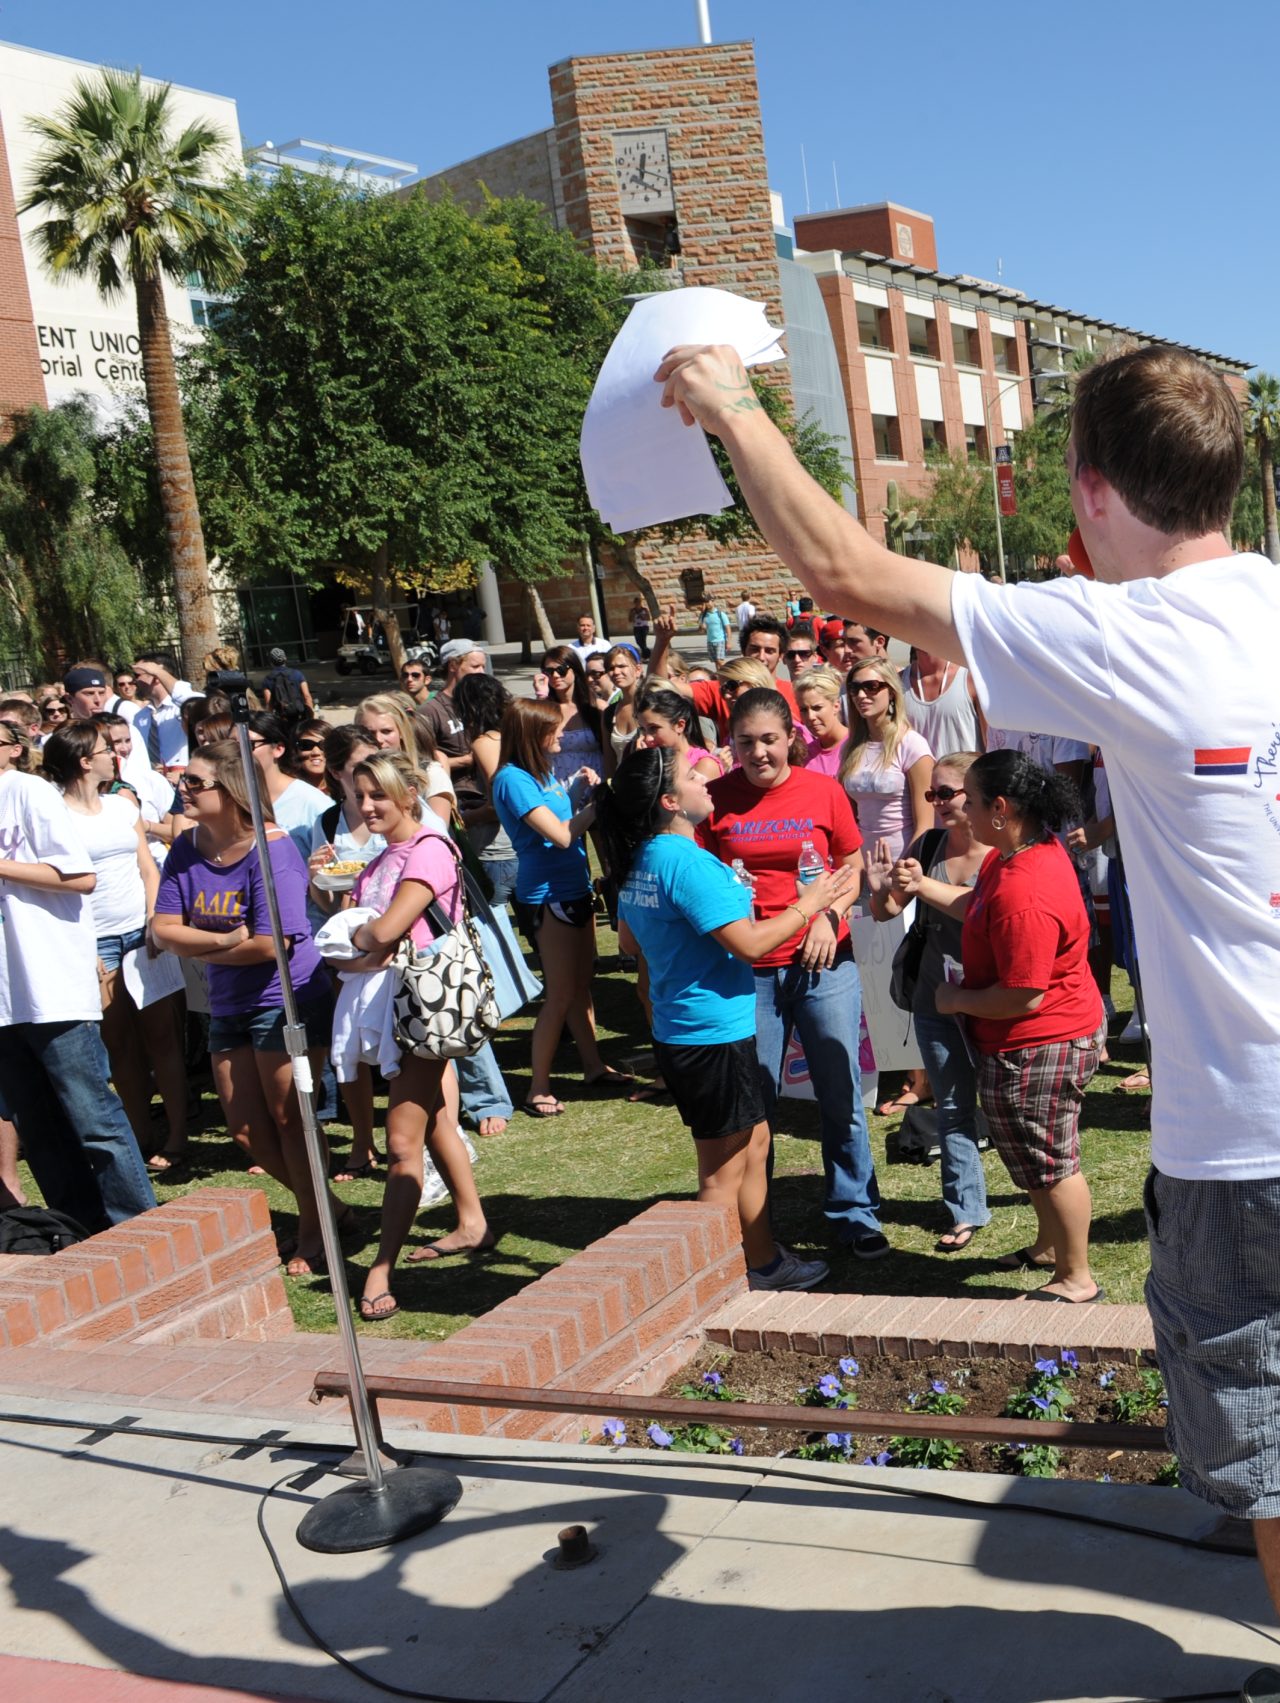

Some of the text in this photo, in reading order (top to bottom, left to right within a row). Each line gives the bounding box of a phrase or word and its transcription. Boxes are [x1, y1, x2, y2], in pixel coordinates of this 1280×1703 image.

[37, 325, 142, 355] ENT UNIO
[40, 354, 147, 381] orial Cente
[729, 817, 815, 835] ARIZONA
